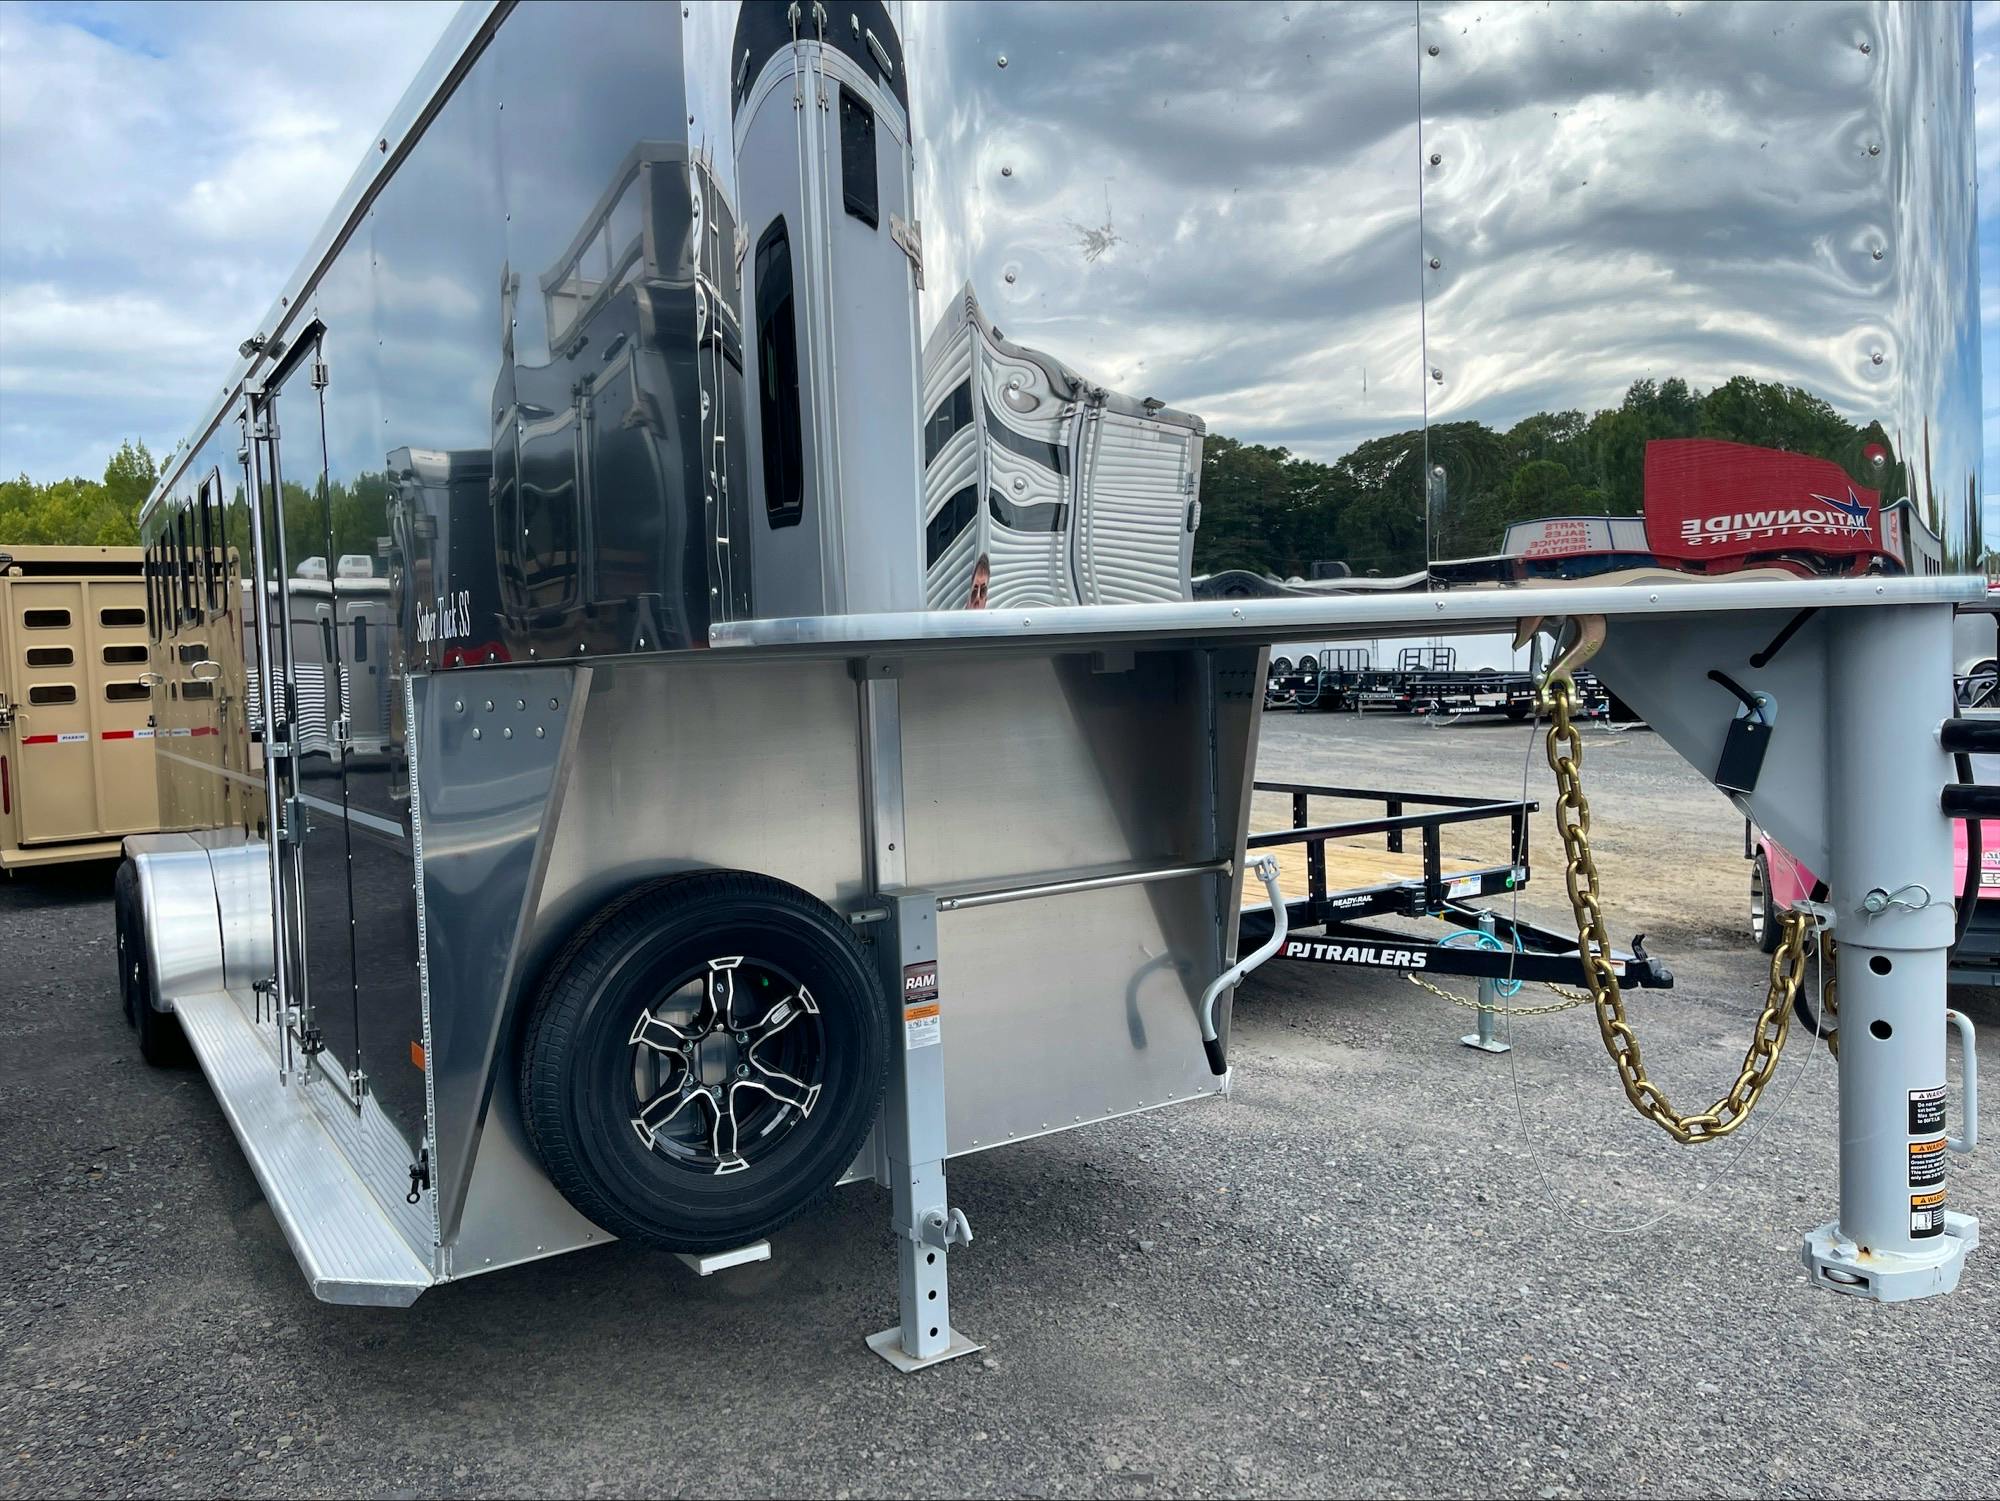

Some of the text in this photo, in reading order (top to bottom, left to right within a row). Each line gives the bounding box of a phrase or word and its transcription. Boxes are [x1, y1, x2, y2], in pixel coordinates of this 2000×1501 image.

[417, 590, 470, 655] Super Tack SS
[1332, 894, 1373, 908] READY-RAIL
[905, 974, 936, 990] RAM
